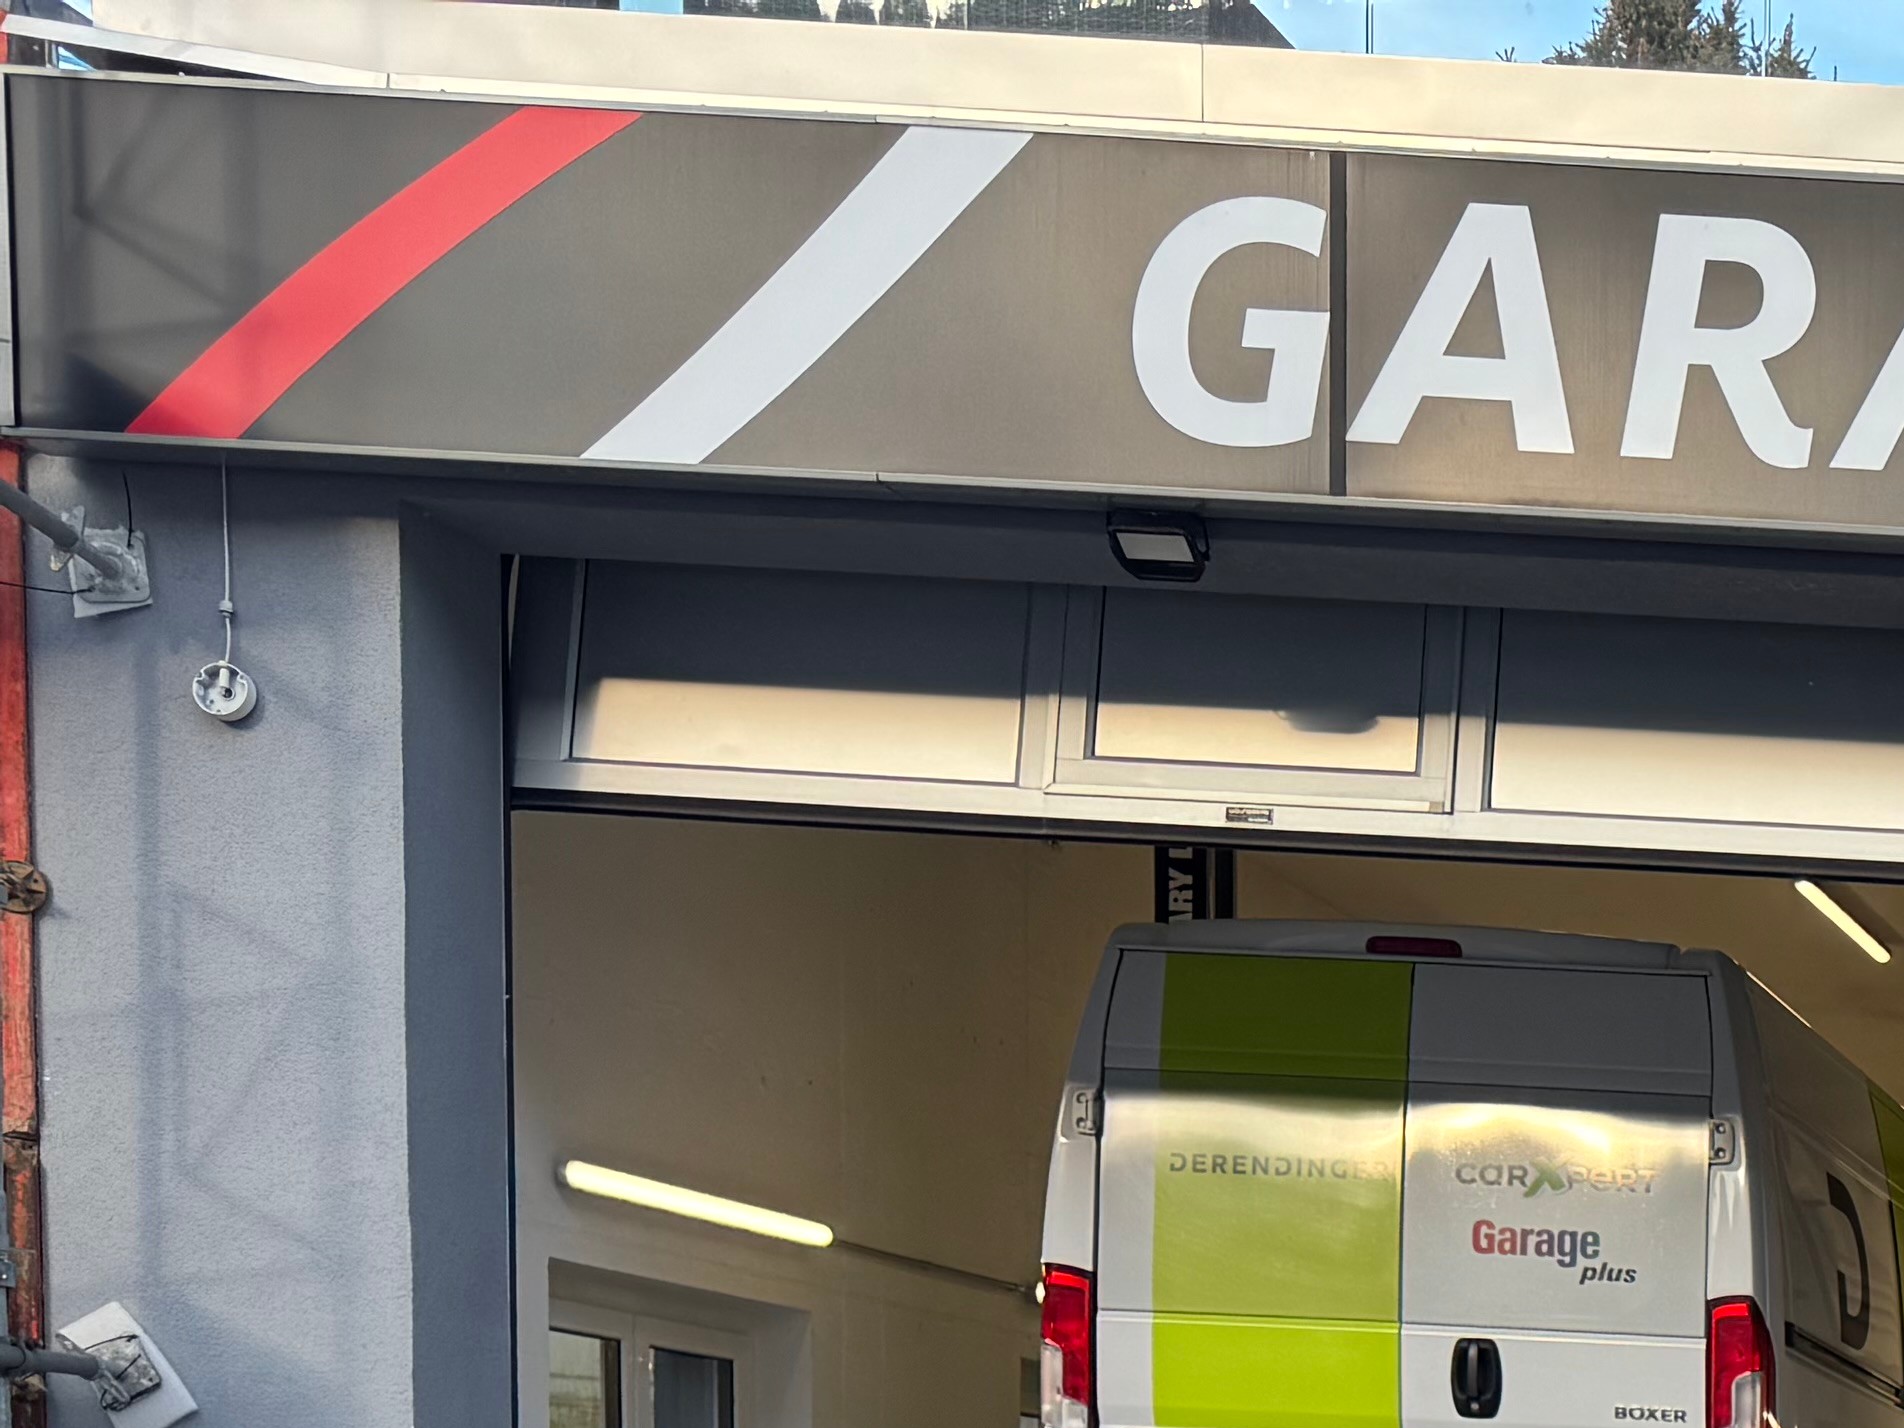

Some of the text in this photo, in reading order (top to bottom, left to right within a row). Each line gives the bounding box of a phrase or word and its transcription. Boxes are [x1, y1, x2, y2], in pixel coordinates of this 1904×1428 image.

[1471, 1219, 1601, 1268] Garage
[1579, 1261, 1637, 1287] plus
[1615, 1406, 1687, 1423] BOXER
